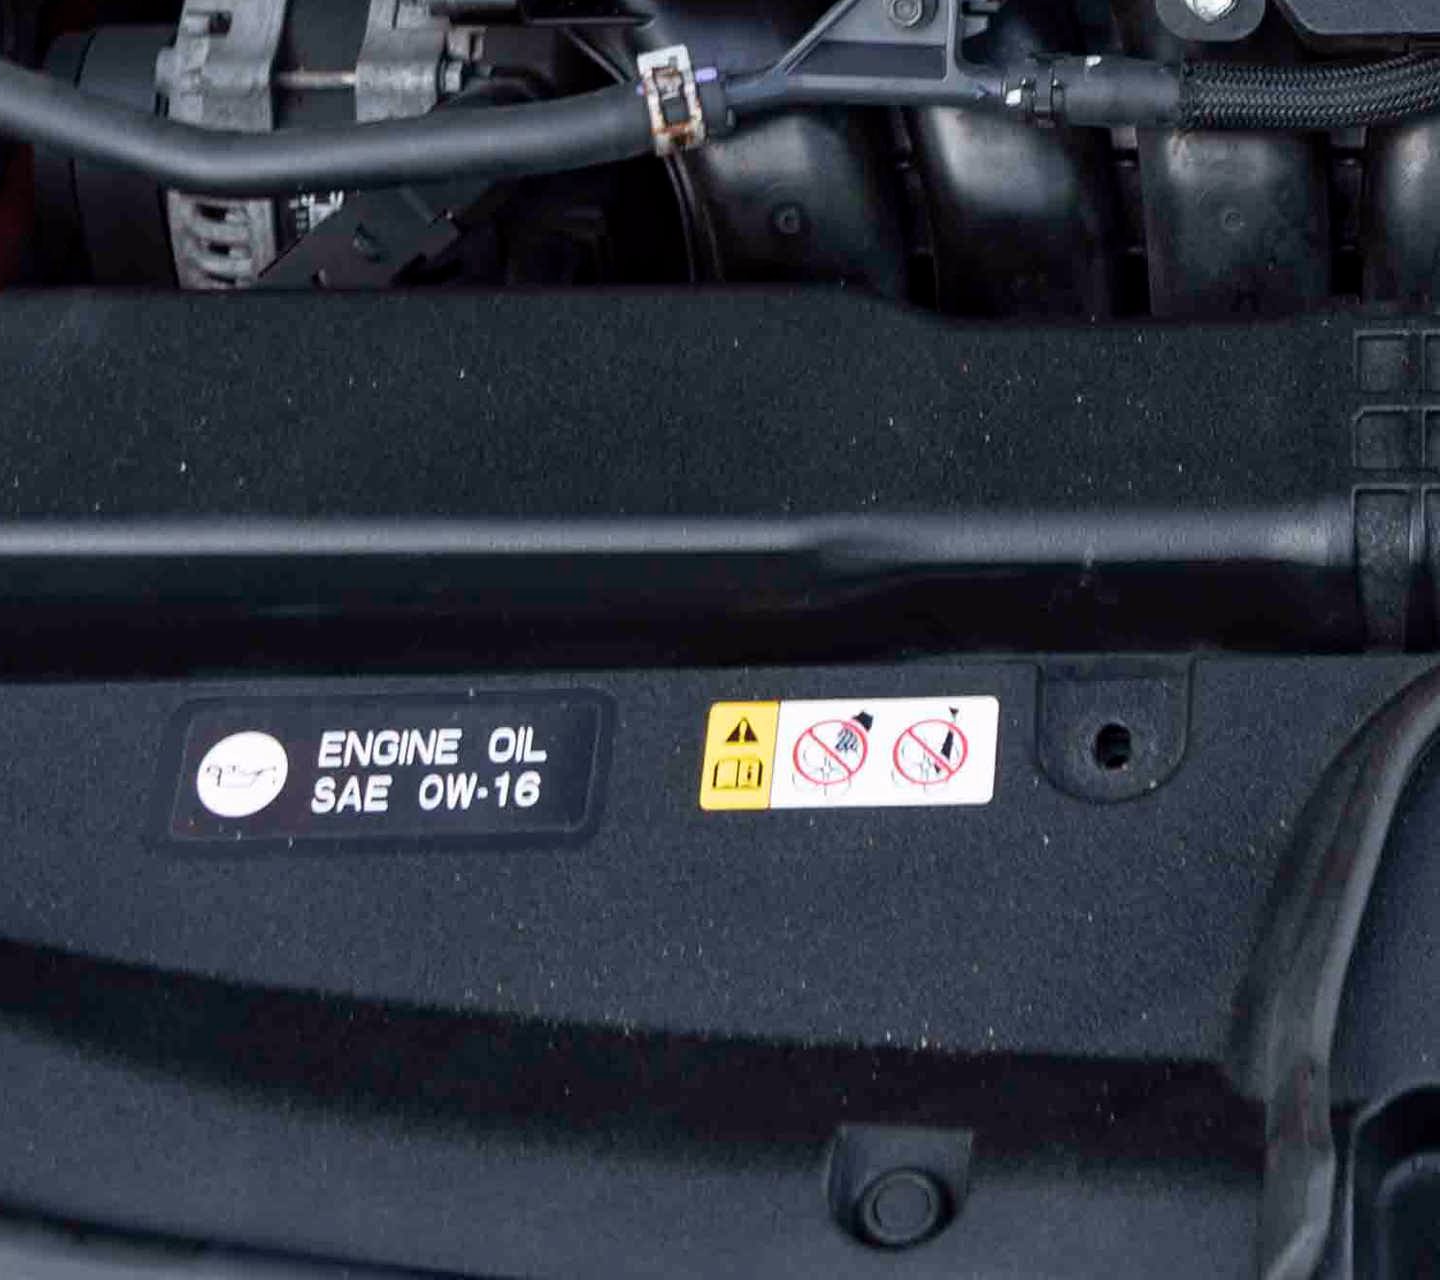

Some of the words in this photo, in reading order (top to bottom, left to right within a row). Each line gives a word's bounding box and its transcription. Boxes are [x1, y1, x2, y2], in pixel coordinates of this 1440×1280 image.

[317, 728, 463, 769] ENGINE
[487, 725, 548, 764] OIL
[310, 774, 393, 814] SAE
